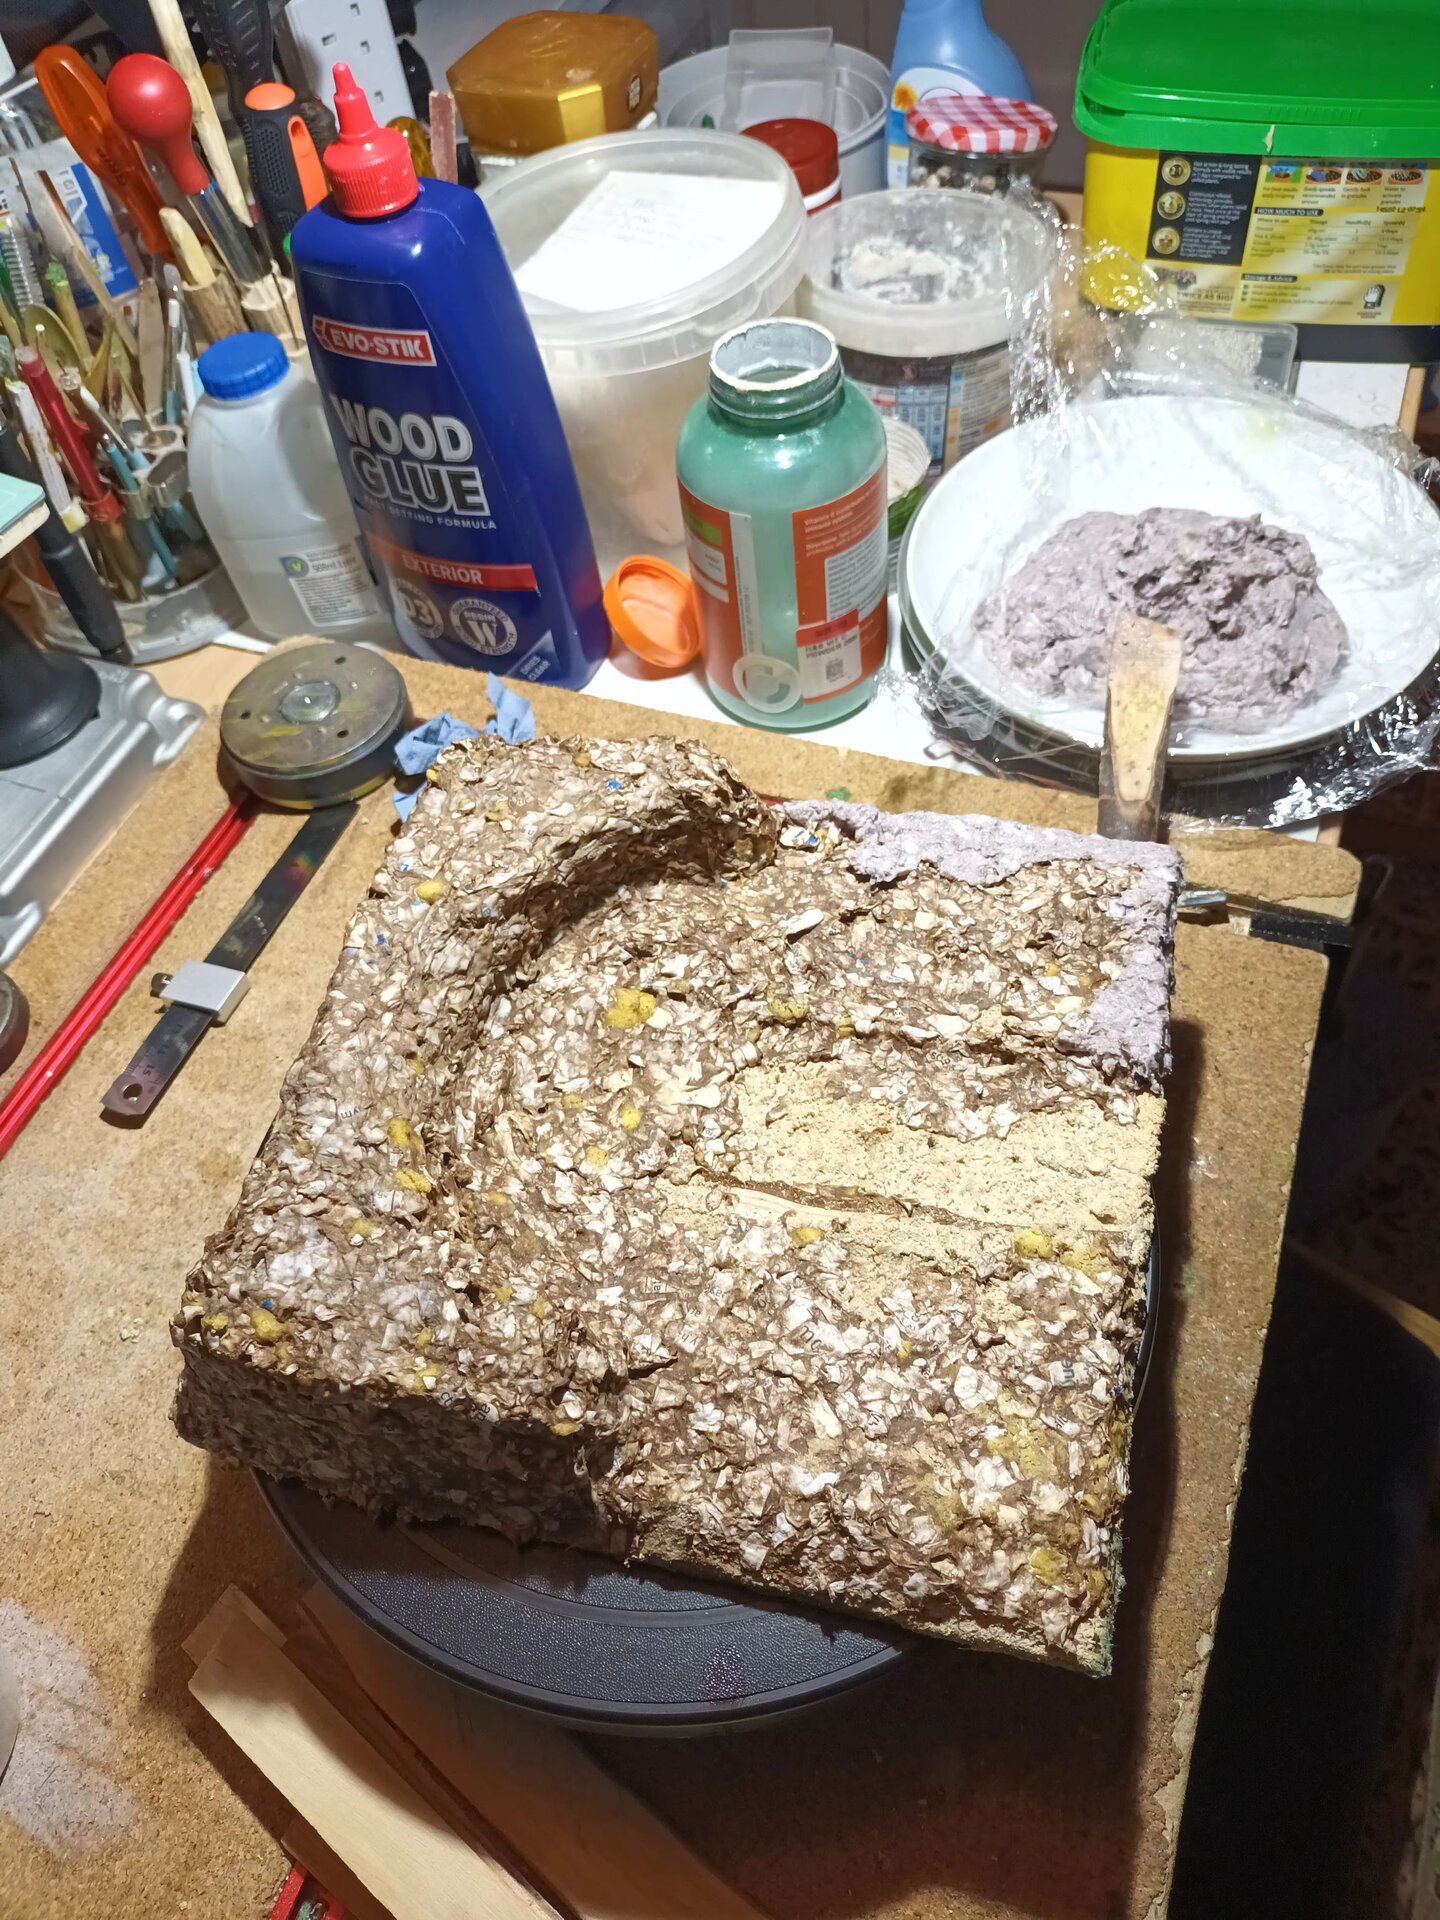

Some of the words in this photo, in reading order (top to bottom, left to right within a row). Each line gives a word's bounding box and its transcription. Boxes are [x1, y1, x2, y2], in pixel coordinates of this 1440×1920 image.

[1274, 208, 1296, 216] MUCH
[330, 393, 474, 463] WOOD
[350, 446, 491, 516] GLUE
[437, 516, 497, 530] FORMULA
[402, 555, 484, 585] EXTERIOR
